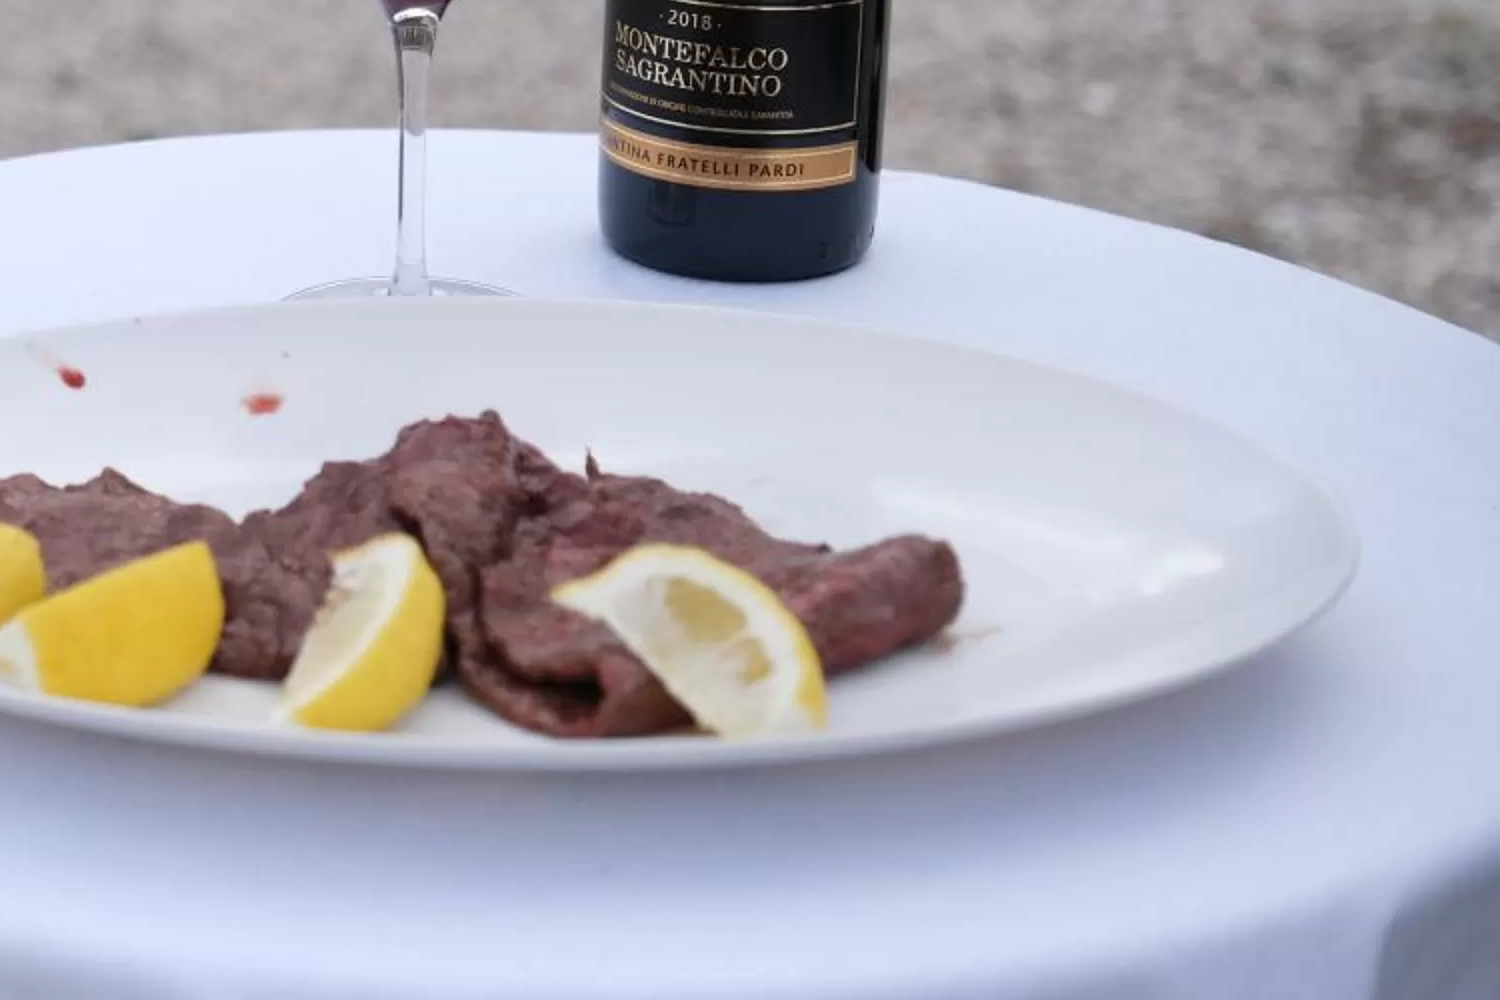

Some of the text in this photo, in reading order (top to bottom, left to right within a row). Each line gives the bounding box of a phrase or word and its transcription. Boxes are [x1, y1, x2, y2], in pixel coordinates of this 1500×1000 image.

[667, 9, 712, 31] 2018
[615, 20, 789, 71] MONTEFALCO
[615, 48, 782, 97] SAGRANTINO
[607, 135, 804, 177] NTINA FRATELLI PARDI
